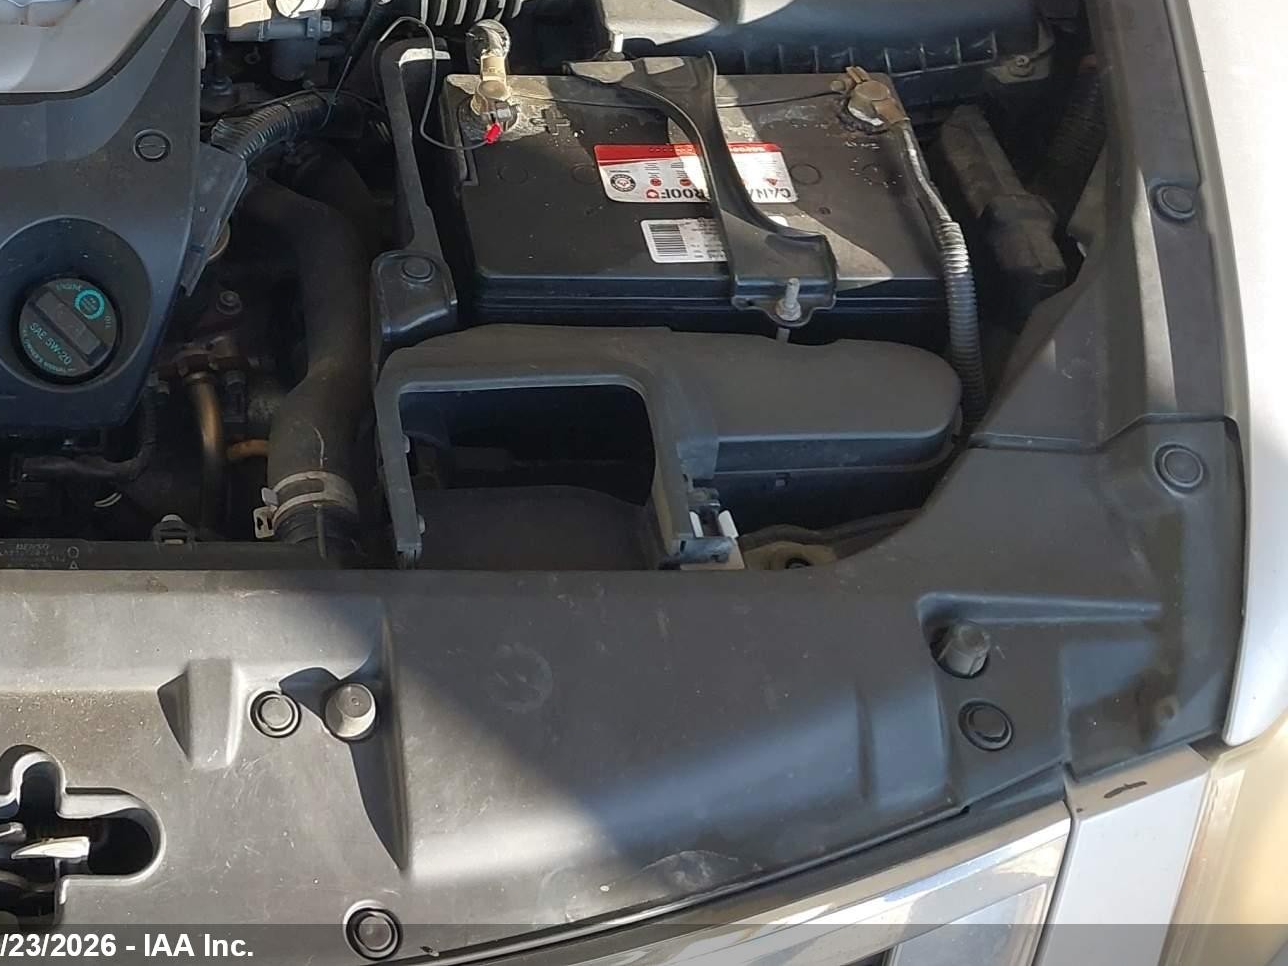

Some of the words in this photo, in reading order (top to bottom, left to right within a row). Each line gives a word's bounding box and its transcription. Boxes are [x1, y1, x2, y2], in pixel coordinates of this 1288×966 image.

[660, 188, 710, 200] ROOF
[30, 322, 48, 340] SAE
[45, 337, 73, 365] 5W-20
